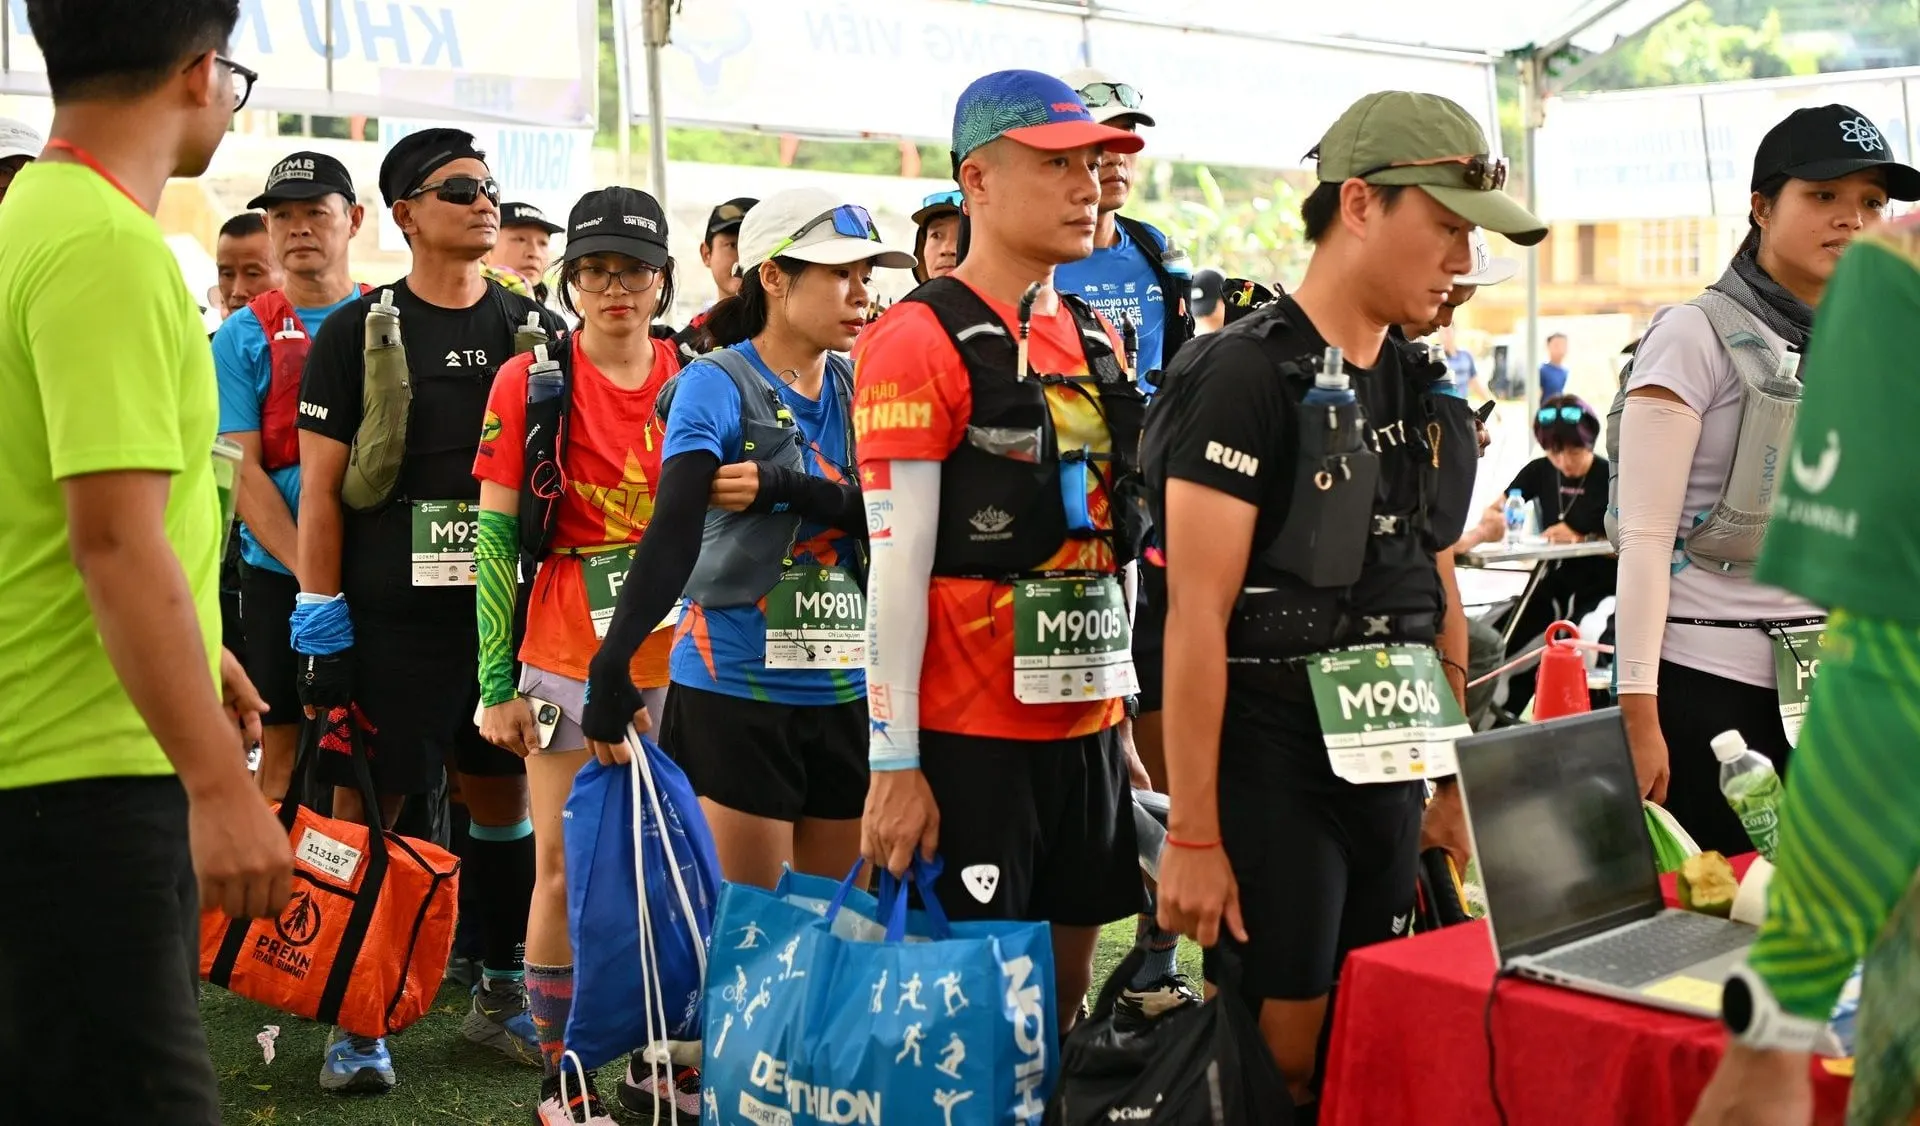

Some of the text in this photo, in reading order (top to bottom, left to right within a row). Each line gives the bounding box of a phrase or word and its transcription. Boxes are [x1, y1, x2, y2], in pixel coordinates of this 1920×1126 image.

[1097, 306, 1141, 320] ERITAGE
[1123, 297, 1139, 306] BAY
[462, 350, 488, 367] T8
[299, 401, 329, 420] RUN
[872, 401, 932, 432] NAM
[1204, 440, 1259, 477] RUN
[431, 521, 479, 543] M93
[795, 592, 863, 619] M9811
[1037, 607, 1121, 643] M9005
[1337, 679, 1441, 720] M9606
[308, 843, 348, 866] 113187
[256, 934, 312, 971] PRENN
[747, 1102, 777, 1124] SPORT
